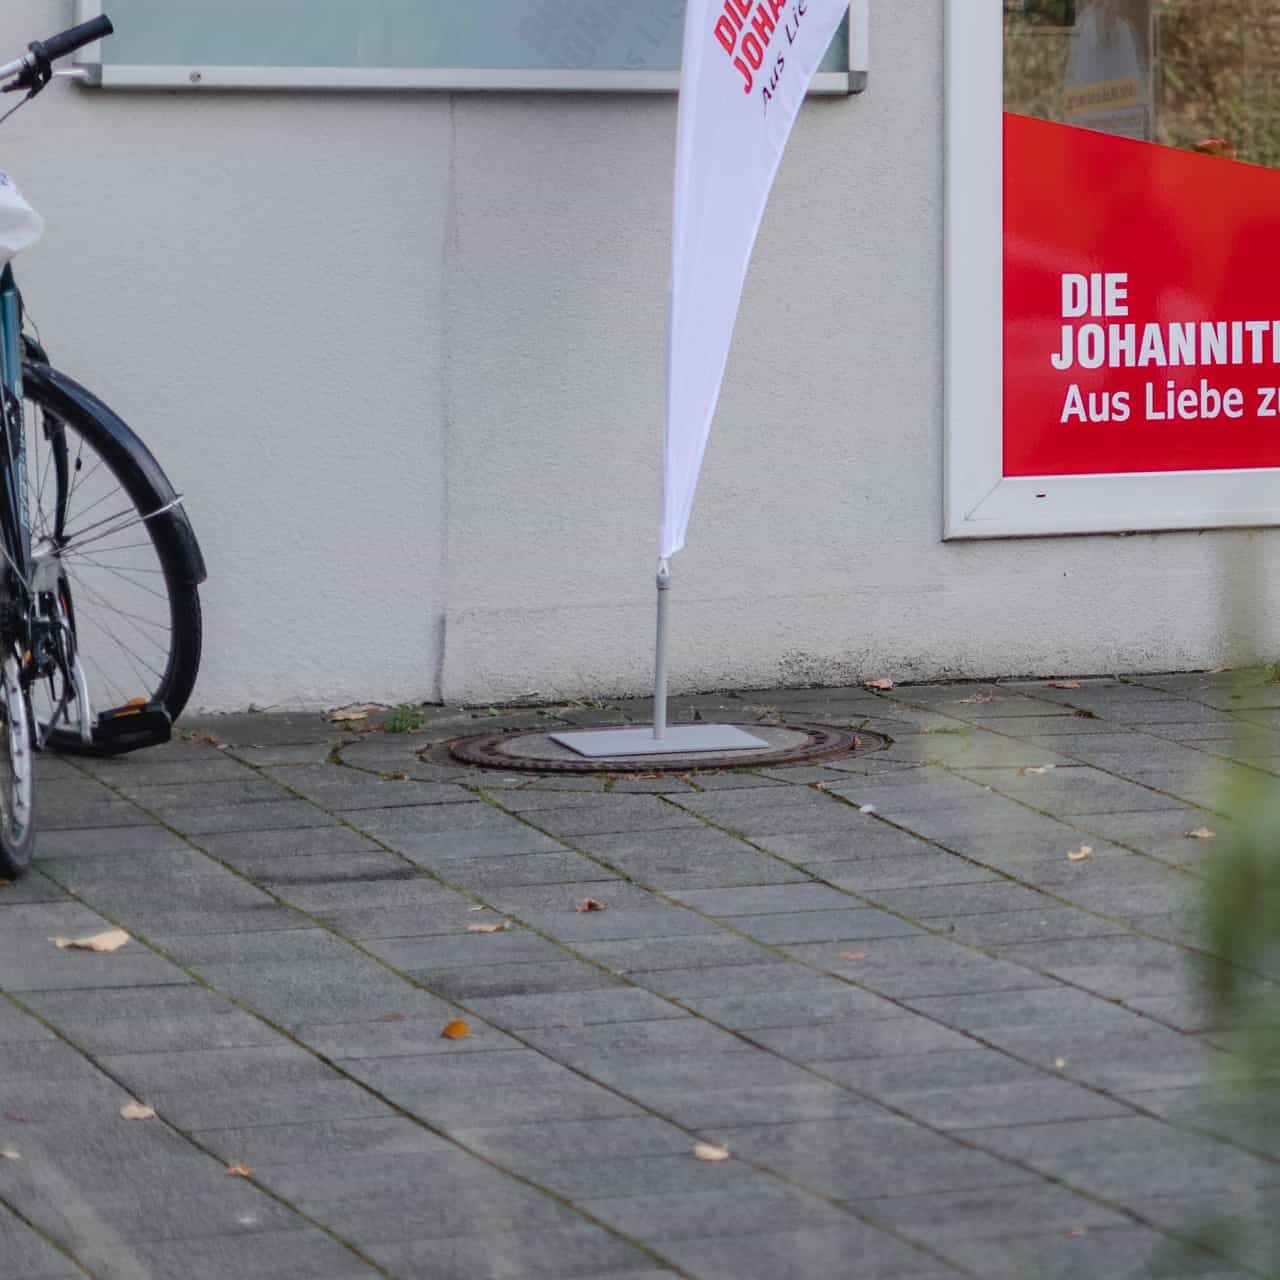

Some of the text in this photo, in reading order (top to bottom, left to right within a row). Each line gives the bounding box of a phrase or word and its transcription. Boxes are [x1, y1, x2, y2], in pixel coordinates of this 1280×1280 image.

[1062, 272, 1128, 318] DIE
[1060, 383, 1131, 423] Aus
[1145, 379, 1244, 420] Liebe
